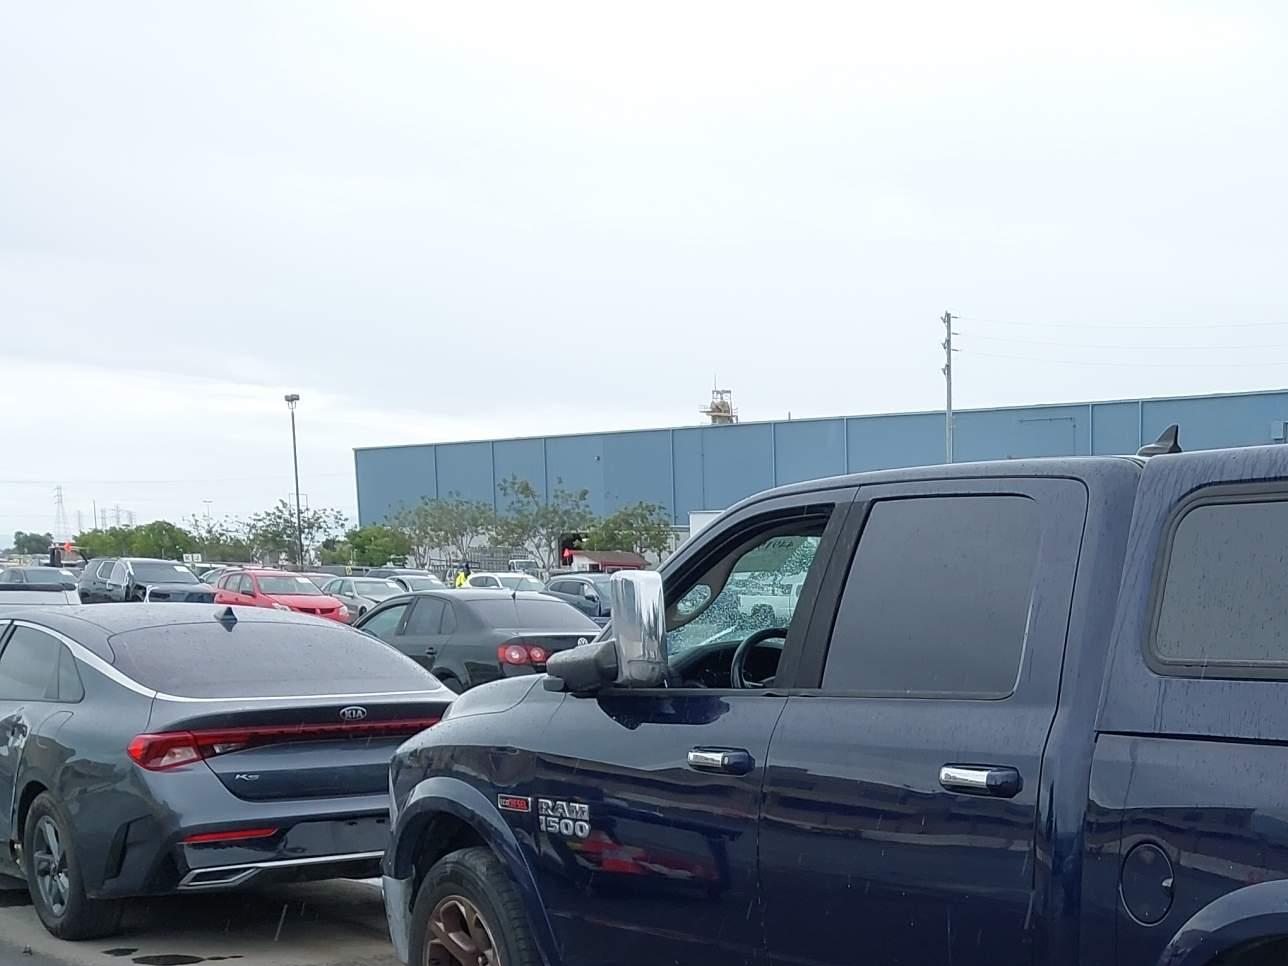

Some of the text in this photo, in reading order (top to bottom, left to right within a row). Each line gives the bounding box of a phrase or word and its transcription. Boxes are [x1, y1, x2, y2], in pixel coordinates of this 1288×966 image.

[343, 708, 364, 720] KIA
[538, 799, 590, 821] RAM
[538, 815, 591, 838] 1500
